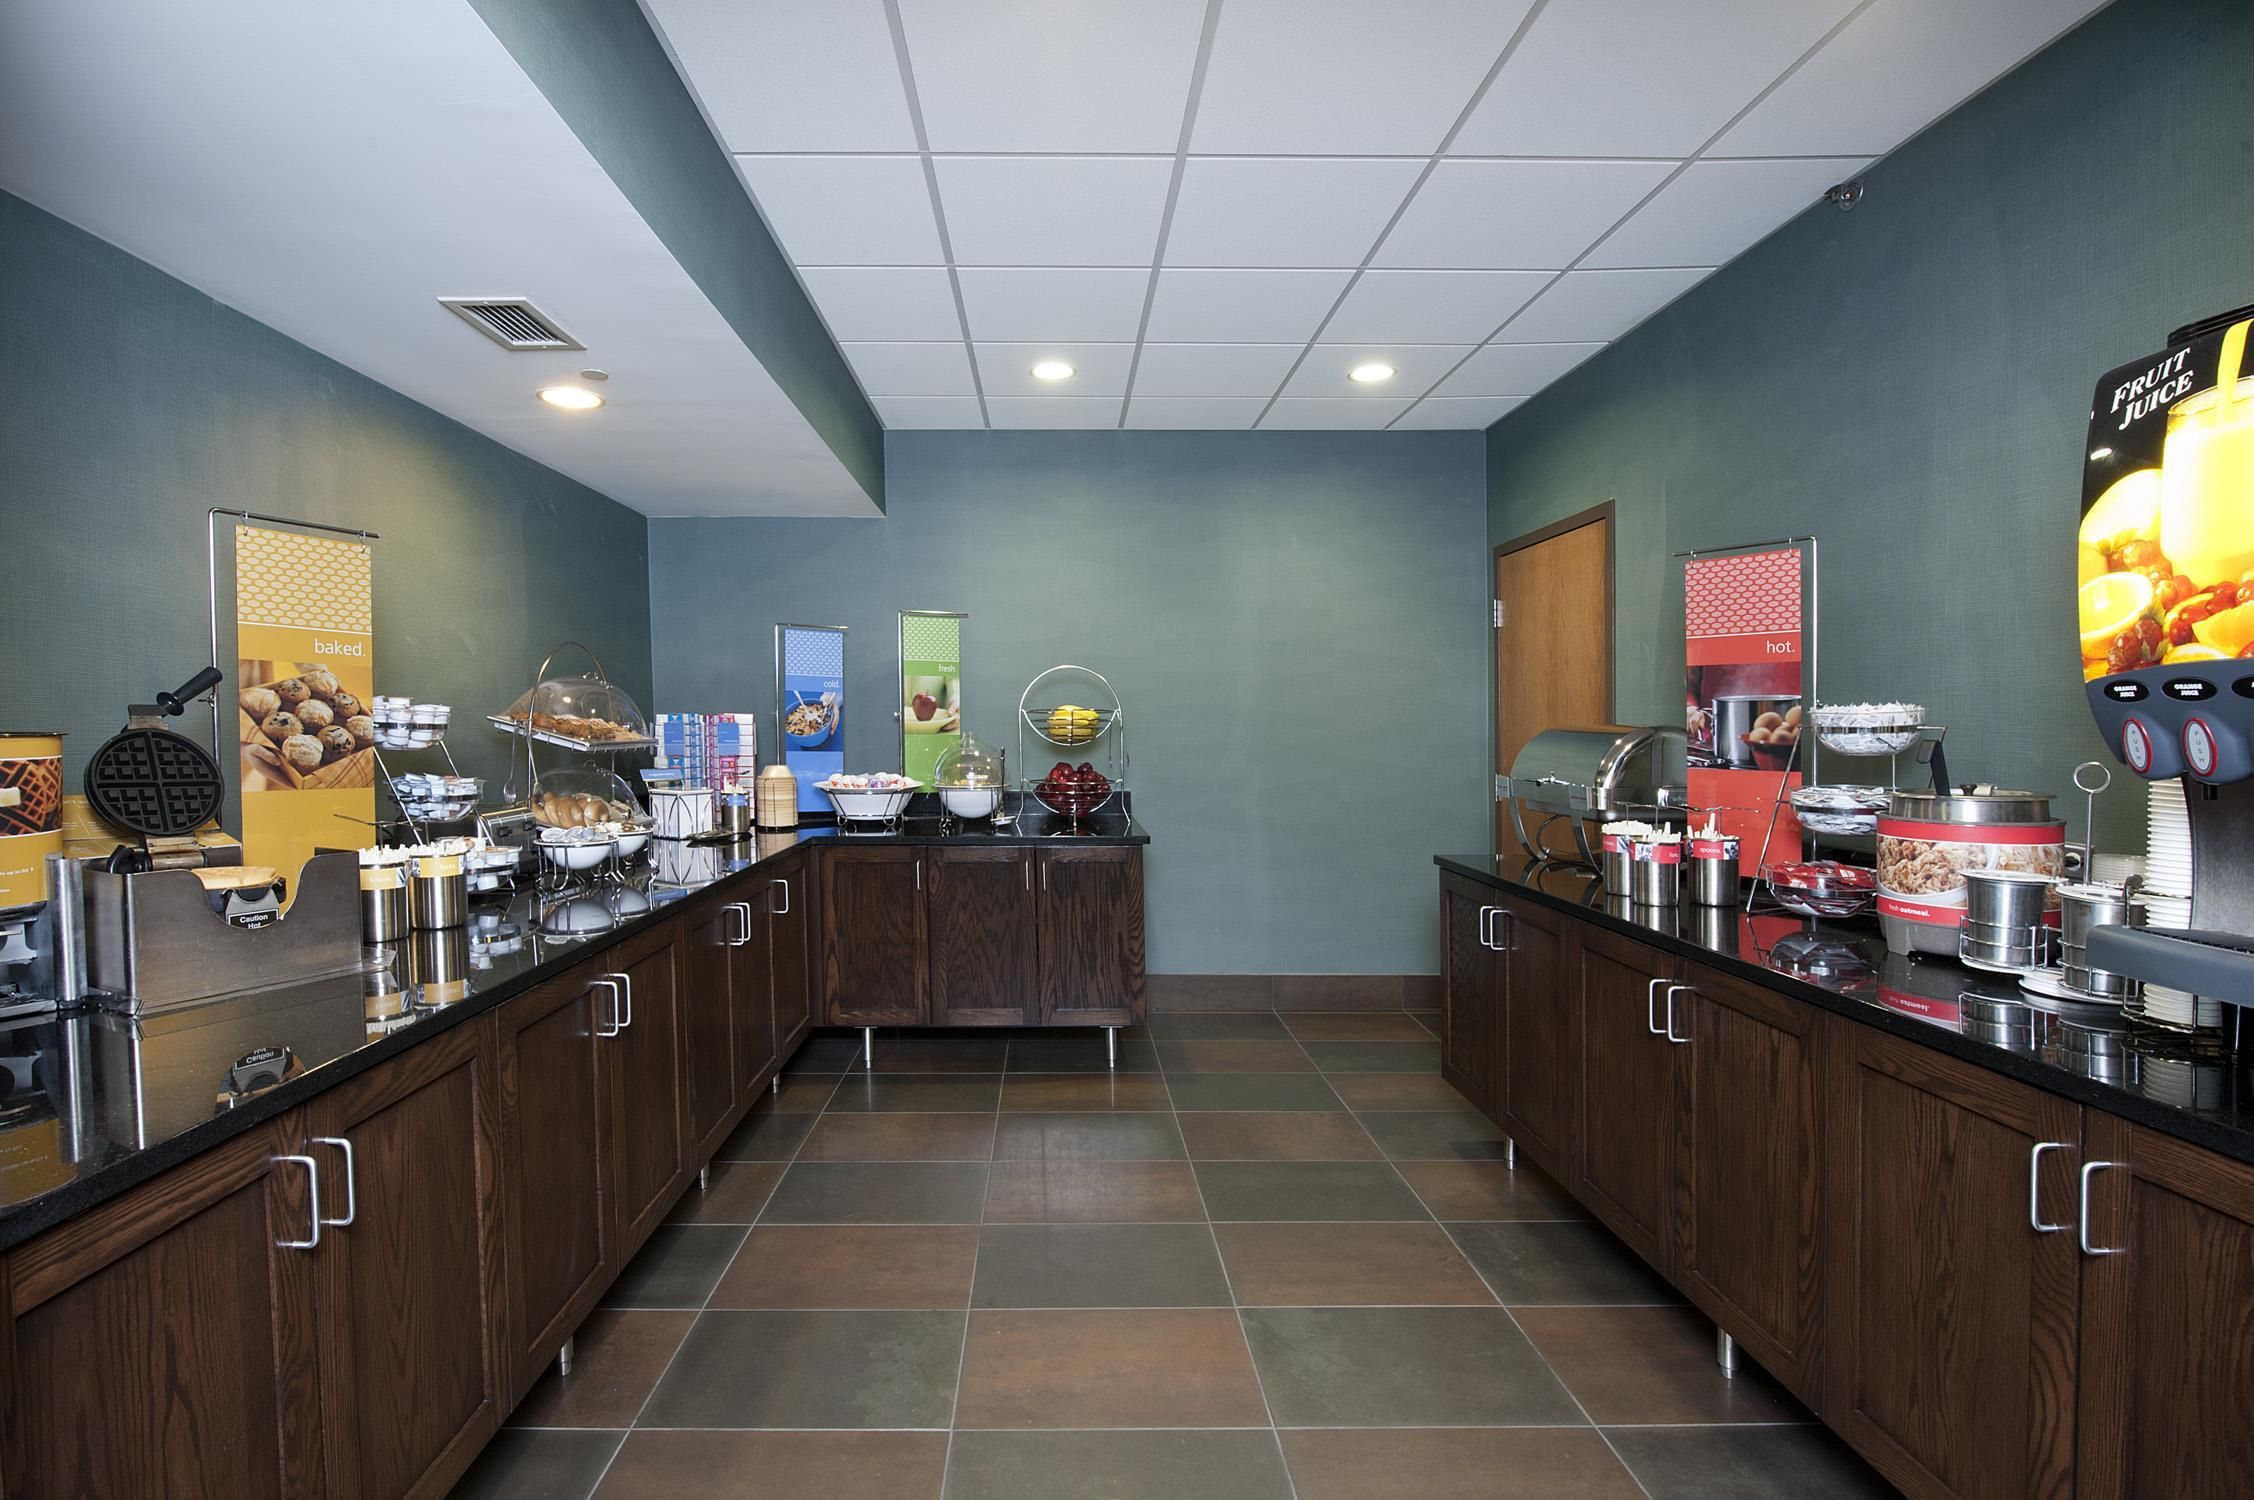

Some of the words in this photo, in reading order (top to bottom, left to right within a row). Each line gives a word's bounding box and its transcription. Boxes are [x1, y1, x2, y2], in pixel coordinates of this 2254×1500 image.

[2110, 347, 2191, 413] FRUIT
[2118, 370, 2194, 430] JUICE
[314, 638, 366, 656] baked.
[1766, 640, 1795, 653] hot.
[2131, 730, 2141, 760] PUSH
[2194, 731, 2205, 762] PUSH
[239, 914, 268, 923] Caution
[1900, 907, 1931, 917] oatmeal.
